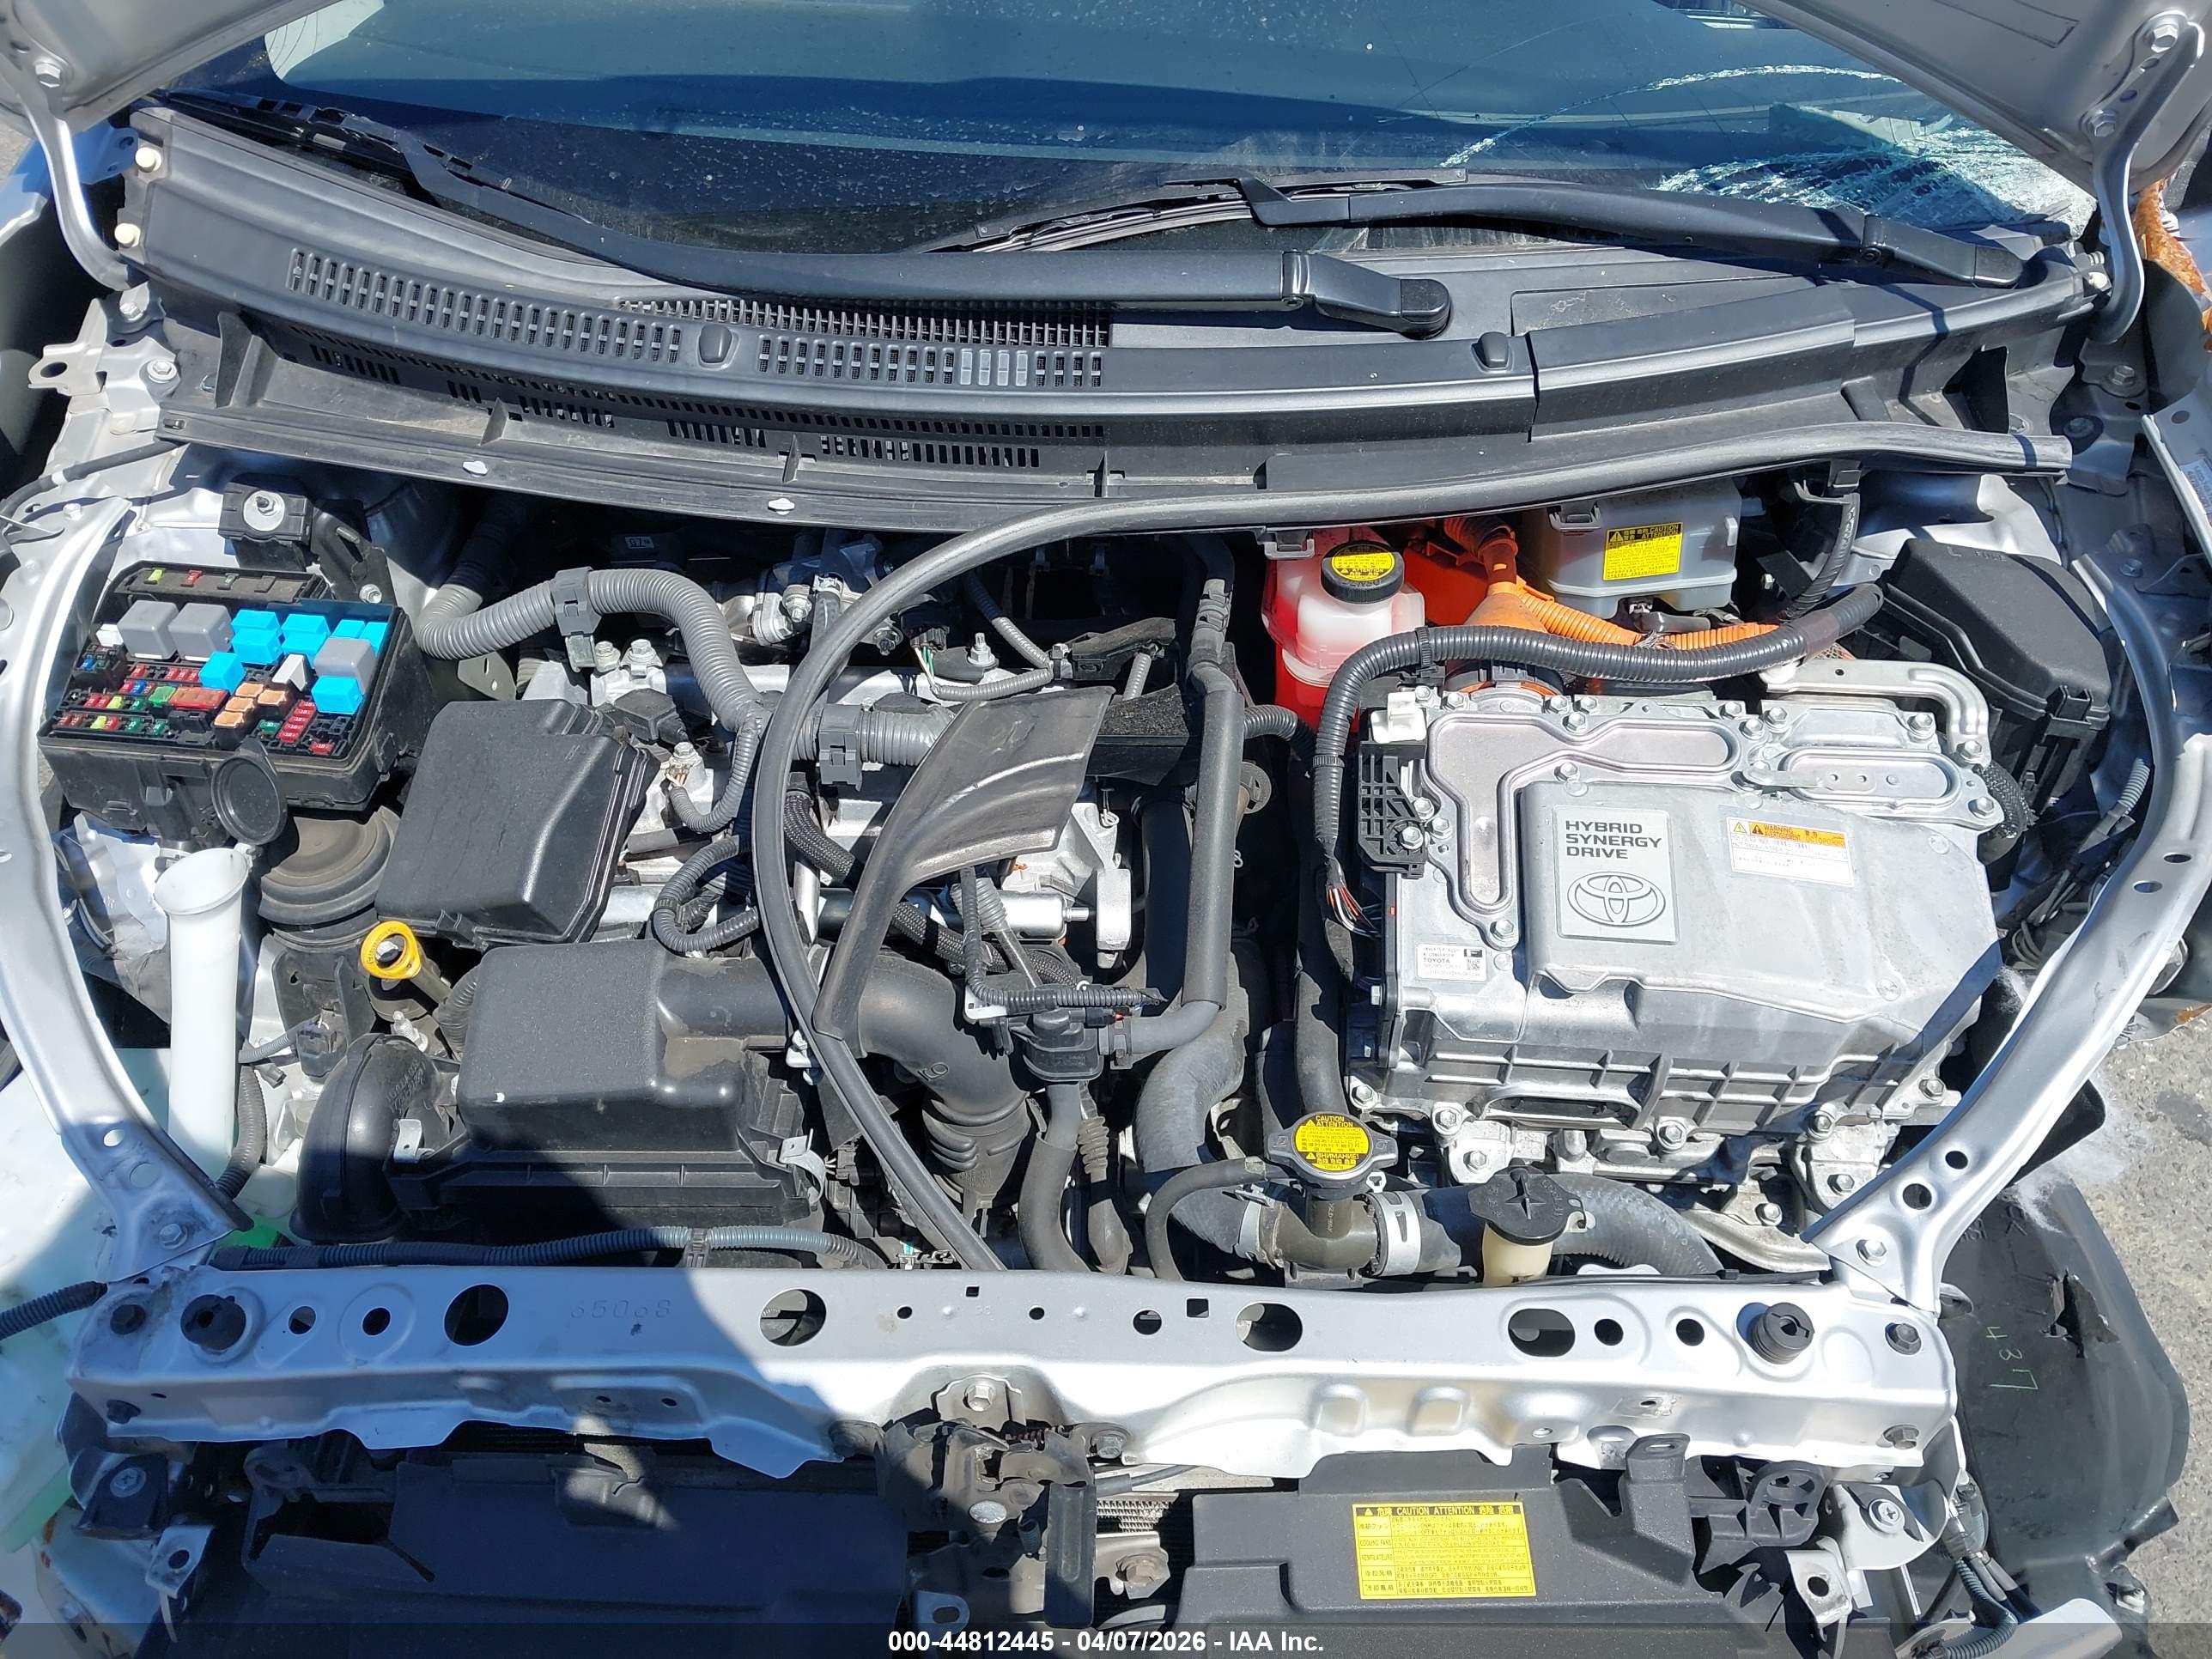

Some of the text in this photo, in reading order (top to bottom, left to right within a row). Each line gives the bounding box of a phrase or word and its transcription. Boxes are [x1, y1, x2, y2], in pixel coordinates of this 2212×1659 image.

[1650, 525, 1679, 533] CAUTION
[1565, 820, 1643, 834] HYBRID
[1765, 824, 1793, 834] WARNING
[1565, 833, 1662, 848] SYNERGY
[1566, 846, 1629, 860] DRIVE
[1396, 1506, 1430, 1516] CAUTION
[1434, 1505, 1475, 1515] ATTENTION
